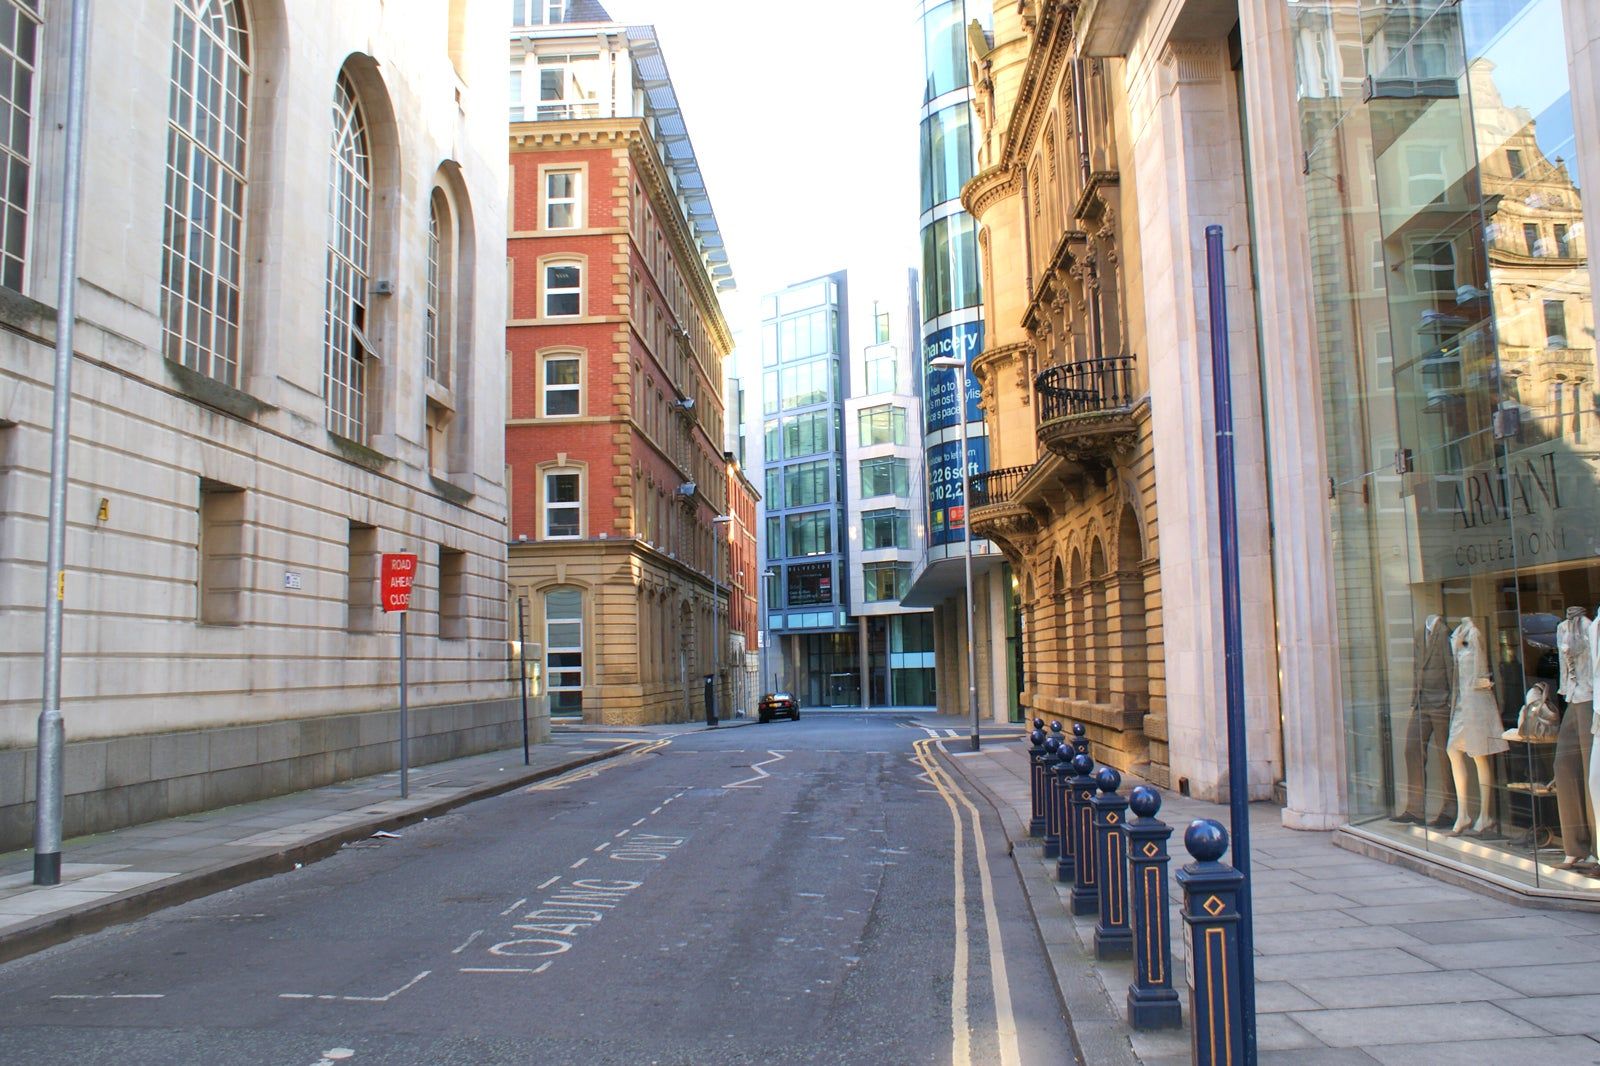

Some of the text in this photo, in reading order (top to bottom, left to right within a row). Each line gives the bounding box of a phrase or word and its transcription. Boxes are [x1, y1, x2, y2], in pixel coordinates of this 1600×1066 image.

[946, 381, 956, 391] to
[934, 393, 954, 407] most
[936, 406, 961, 420] space
[967, 462, 979, 477] ft
[1452, 451, 1562, 532] ARMANI
[1455, 527, 1567, 567] COLLEZIONI
[391, 559, 412, 570] ROAD
[459, 833, 687, 974] LOADING ONLY
